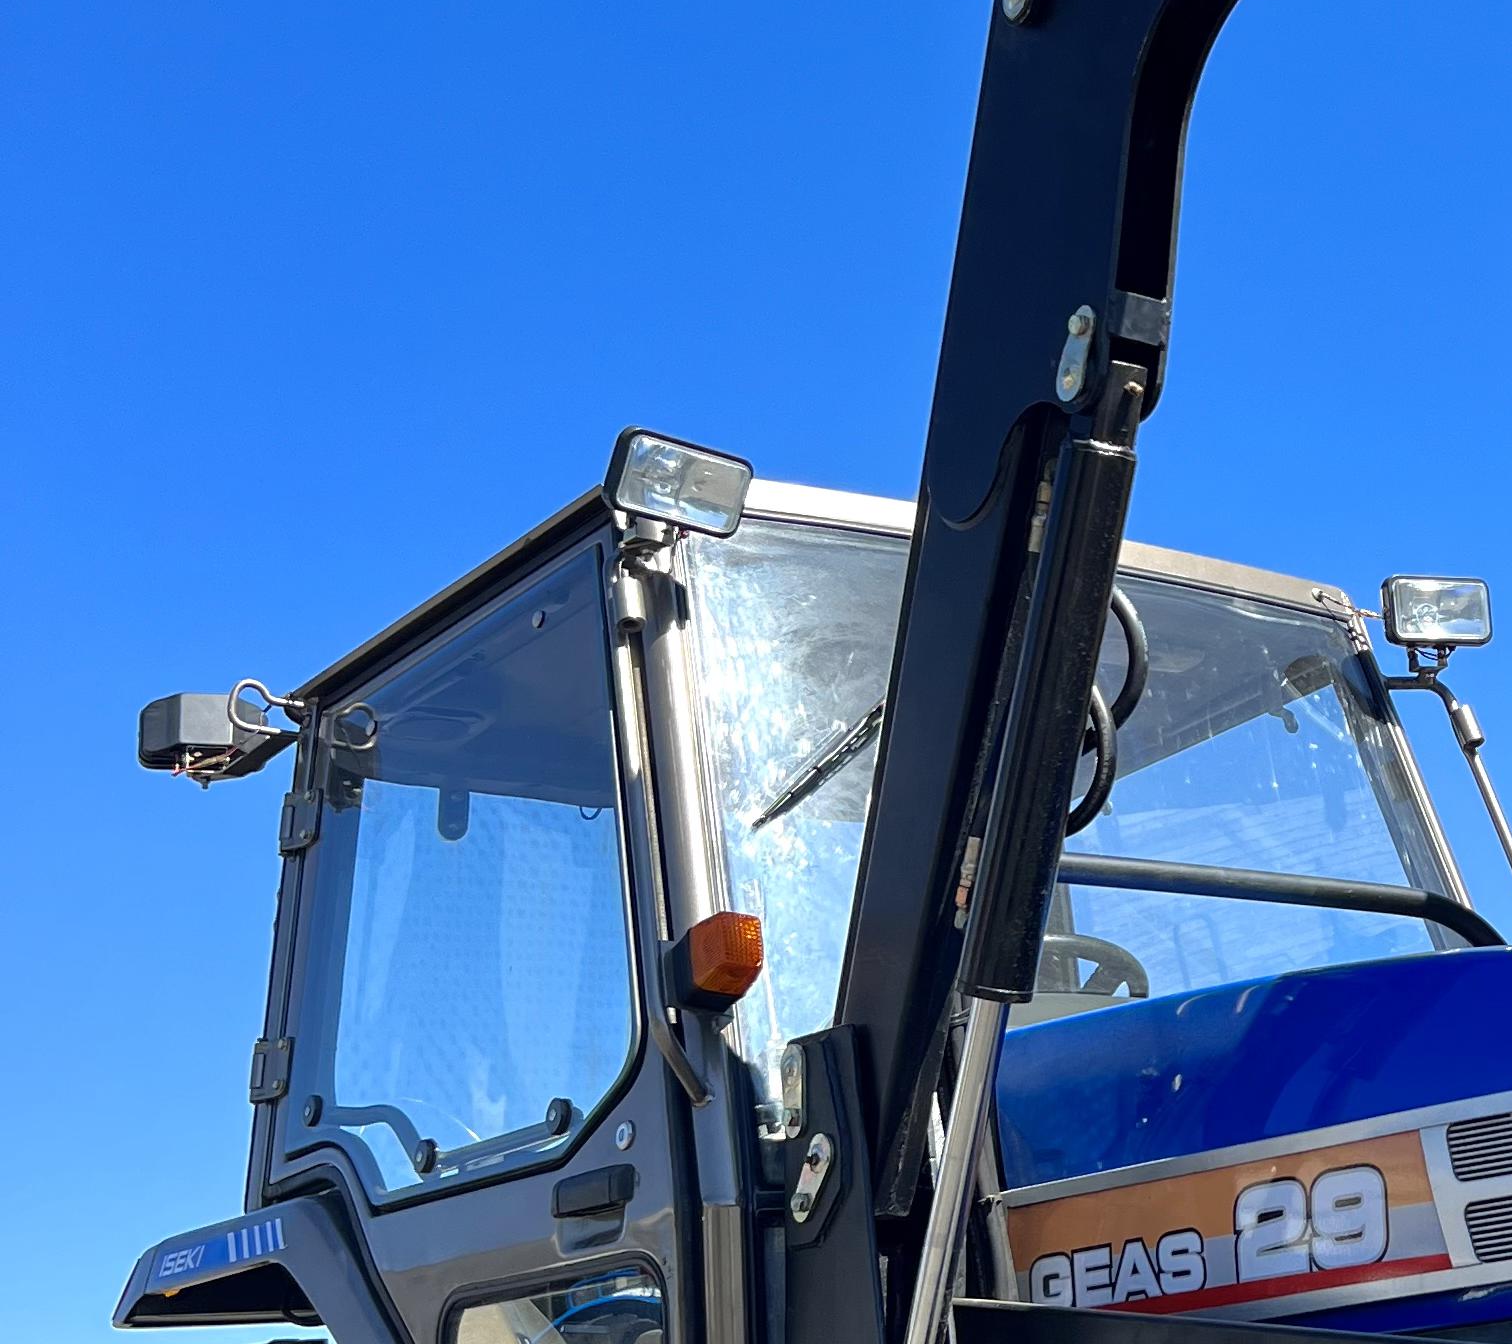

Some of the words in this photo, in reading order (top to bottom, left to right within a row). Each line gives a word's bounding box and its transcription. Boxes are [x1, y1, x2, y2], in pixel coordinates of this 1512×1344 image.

[159, 1244, 206, 1277] ISEKI
[1030, 1227, 1207, 1307] GEAS
[1233, 1163, 1389, 1284] 29
